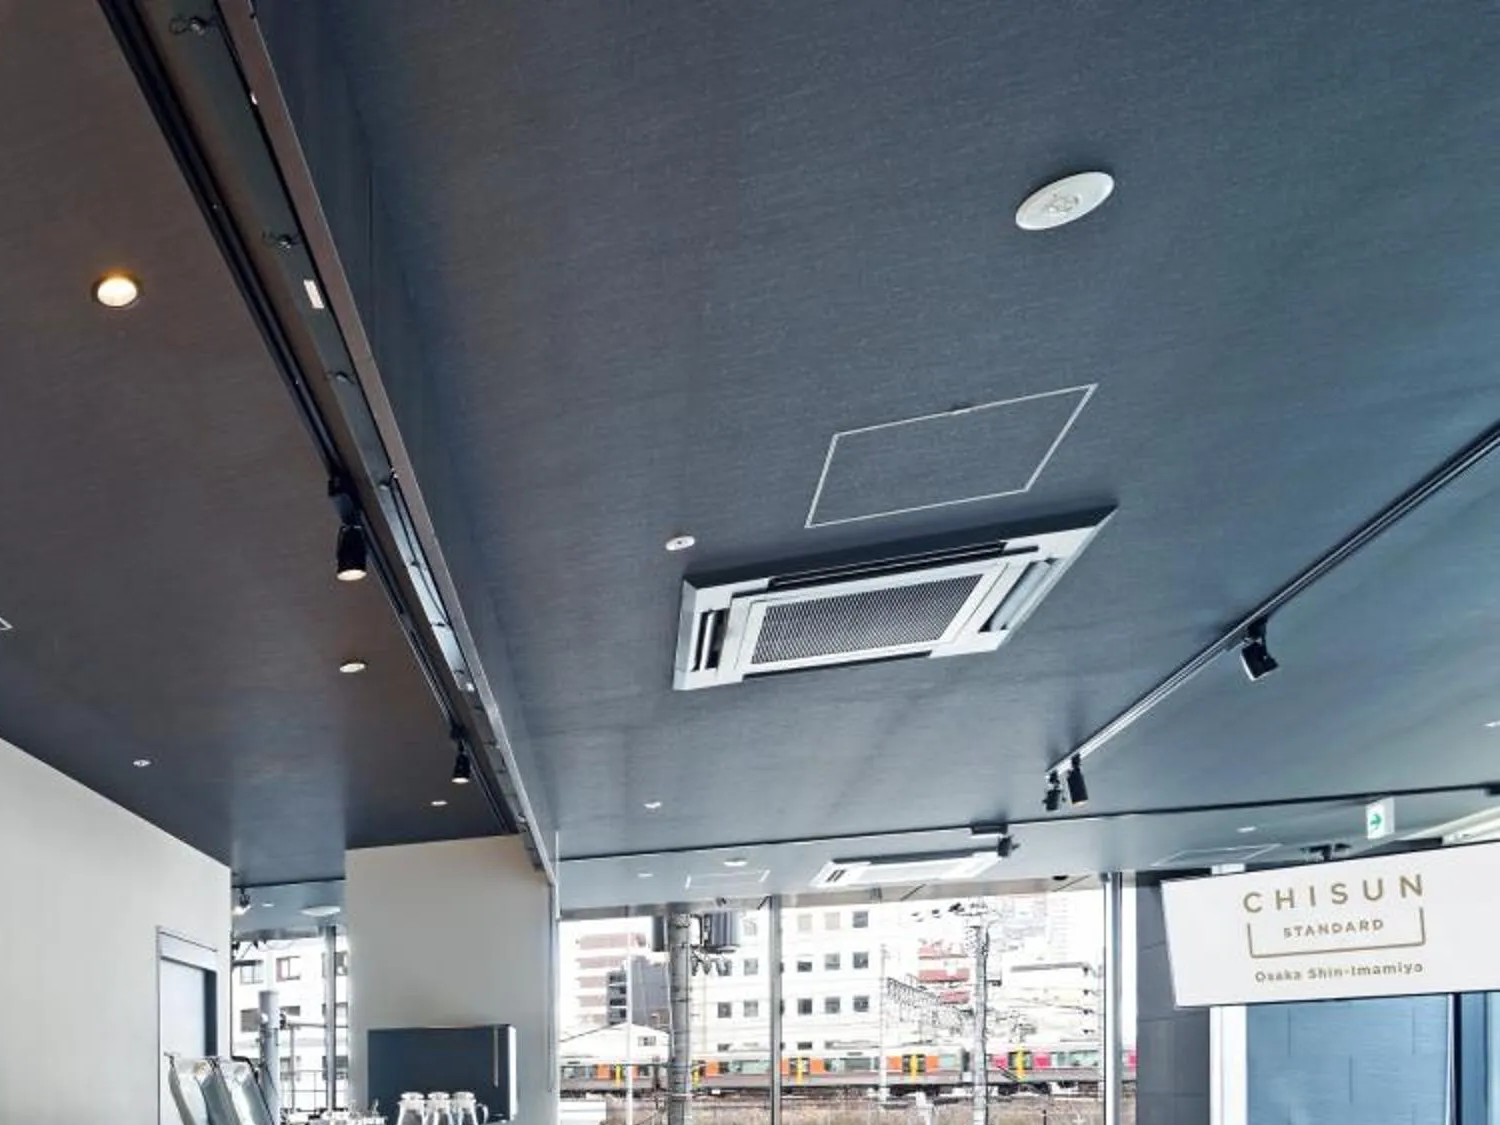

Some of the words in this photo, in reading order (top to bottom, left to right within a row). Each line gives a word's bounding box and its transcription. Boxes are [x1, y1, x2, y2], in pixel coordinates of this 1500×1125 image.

[1242, 873, 1423, 914] CHISUN
[1283, 918, 1384, 939] STANDARD
[1255, 969, 1302, 983] Osaka
[1307, 961, 1424, 980] Shin-Imamiya
